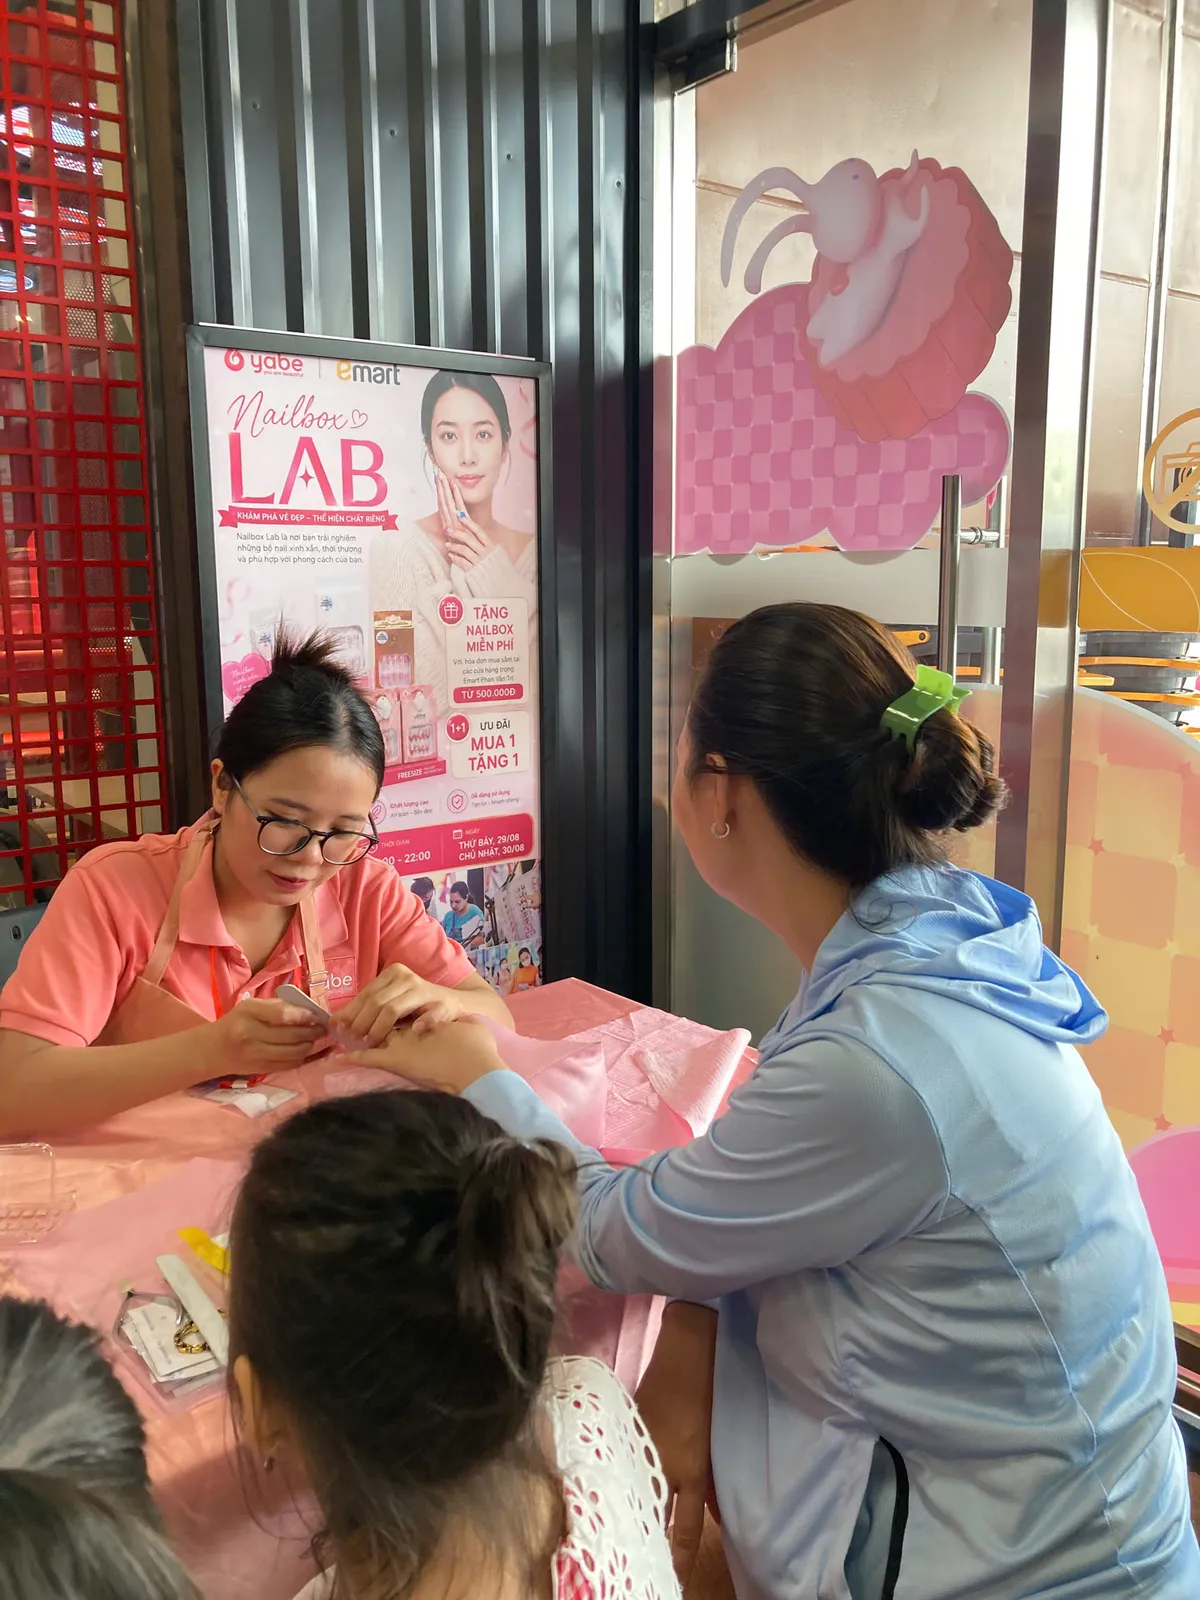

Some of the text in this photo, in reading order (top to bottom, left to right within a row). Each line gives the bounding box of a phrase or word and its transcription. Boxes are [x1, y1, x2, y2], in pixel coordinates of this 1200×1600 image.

[250, 352, 303, 373] yabe
[227, 391, 348, 438] Nailbox
[229, 432, 388, 506] LAB
[237, 511, 260, 520] KHÁM
[262, 512, 277, 520] PHÁ
[328, 514, 344, 522] HIỆN
[366, 514, 386, 522] RIÊNG
[302, 534, 316, 542] bạn
[331, 534, 356, 543] nghiệm
[293, 556, 315, 564] phong
[474, 604, 508, 622] TẶNG
[466, 624, 514, 636] NAILBOX
[467, 637, 514, 652] MIỄN PHÍ
[476, 688, 516, 698] 500.000Đ
[450, 722, 466, 734] 1+1
[480, 718, 510, 730] ƯU ĐÃI
[471, 734, 514, 751] MUA 1
[468, 752, 518, 774] TẶNG 1
[398, 768, 422, 780] FREESIZE
[459, 838, 476, 850] THỨ
[497, 834, 520, 844] 29/08
[404, 850, 430, 863] 22:00
[458, 849, 476, 860] CHỦ
[502, 844, 524, 854] 30/08
